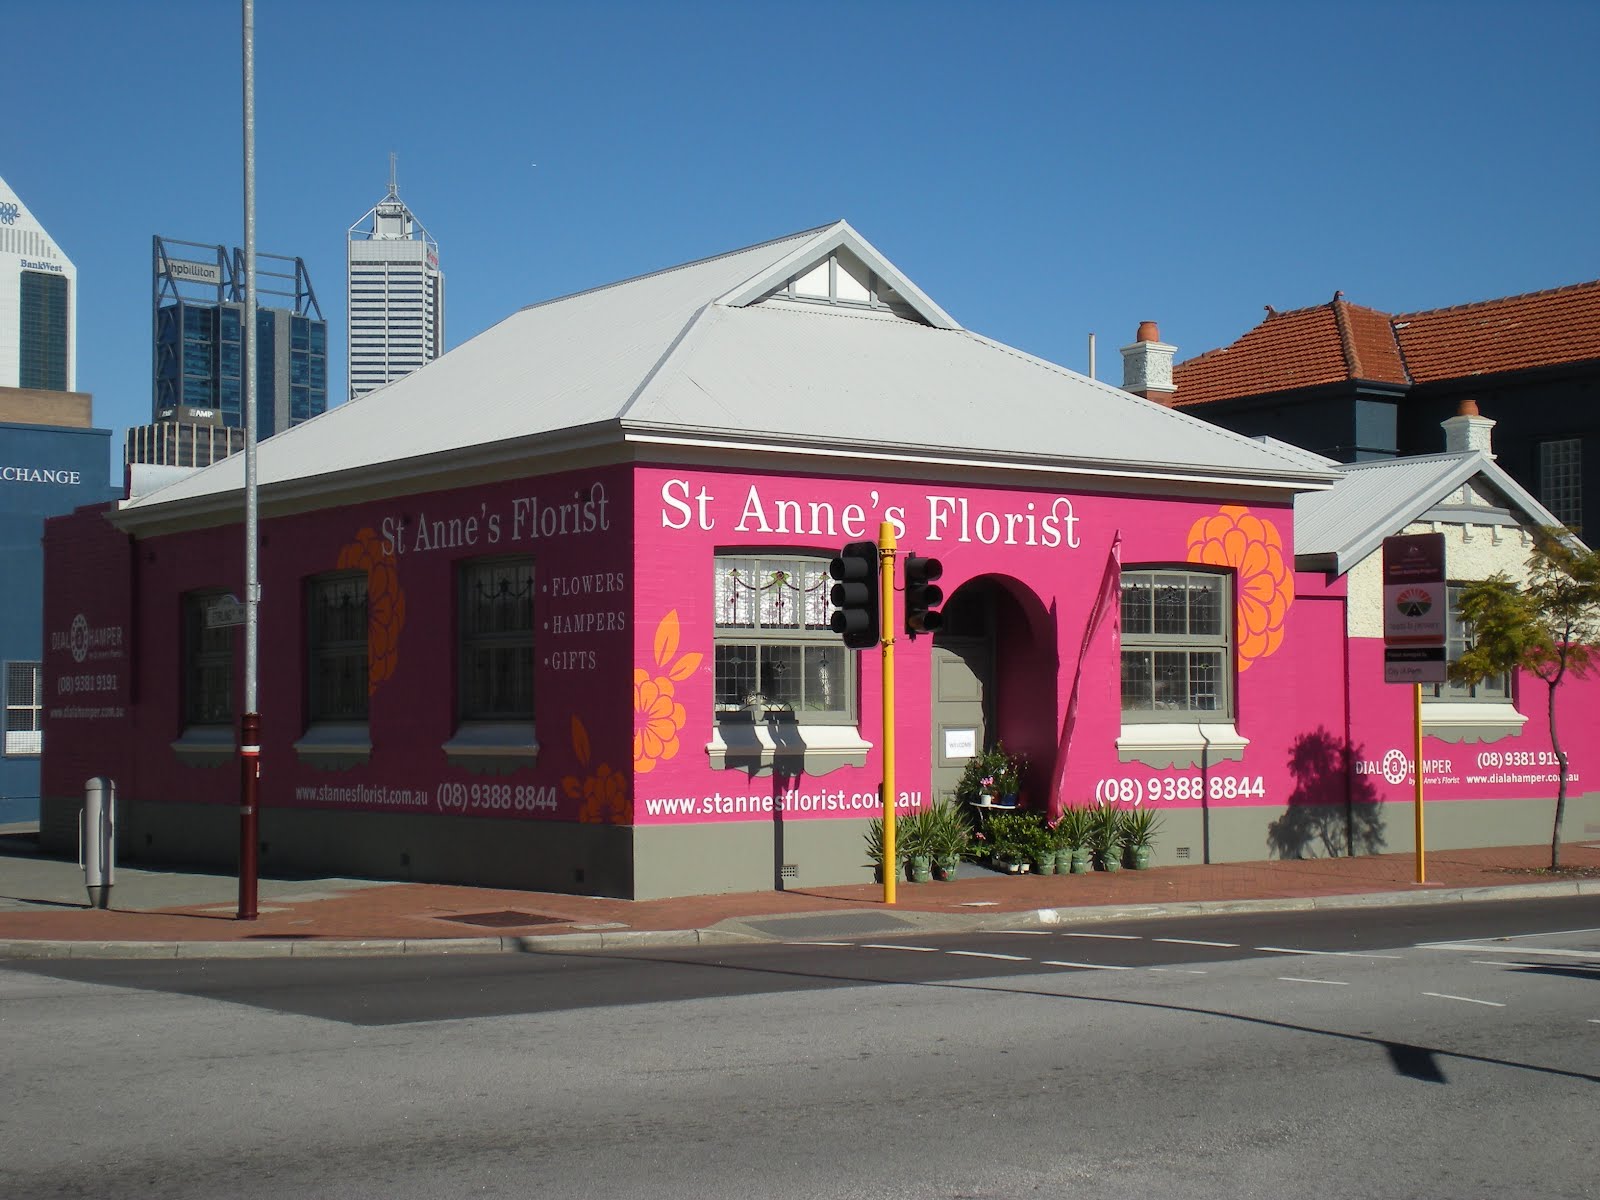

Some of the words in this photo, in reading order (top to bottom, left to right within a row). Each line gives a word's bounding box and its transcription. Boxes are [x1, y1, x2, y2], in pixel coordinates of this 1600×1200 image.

[20, 259, 63, 272] BankWest
[168, 262, 215, 278] hpbilliton
[195, 409, 213, 418] AMP
[0, 466, 81, 485] CHANGE
[381, 516, 405, 556] St
[413, 503, 501, 552] Anne's
[512, 482, 610, 541] Florist
[661, 478, 715, 531] St
[734, 484, 906, 540] Anne's
[926, 495, 1080, 548] Florist
[552, 572, 625, 597] FLOWERS
[552, 611, 626, 635] HAMPERS
[52, 632, 71, 650] DIAL
[88, 626, 122, 649] HAMPER
[552, 651, 597, 671] GIFTS
[57, 676, 74, 695] (08)
[75, 675, 95, 691] 9381
[96, 674, 117, 691] 9191
[1356, 760, 1382, 774] DIAL
[1408, 759, 1452, 773] HMPER
[1477, 752, 1503, 769] (08)
[1504, 752, 1536, 766] 9381
[1095, 778, 1142, 806] (08)
[1148, 777, 1204, 801] 9388
[1210, 776, 1265, 799] 8844
[1408, 777, 1416, 786] by
[1442, 776, 1460, 784] Florist
[295, 783, 428, 806] www.stannesflorist.com.au
[436, 782, 468, 812] (08)
[471, 783, 513, 809] 9388
[514, 785, 558, 812] 8844
